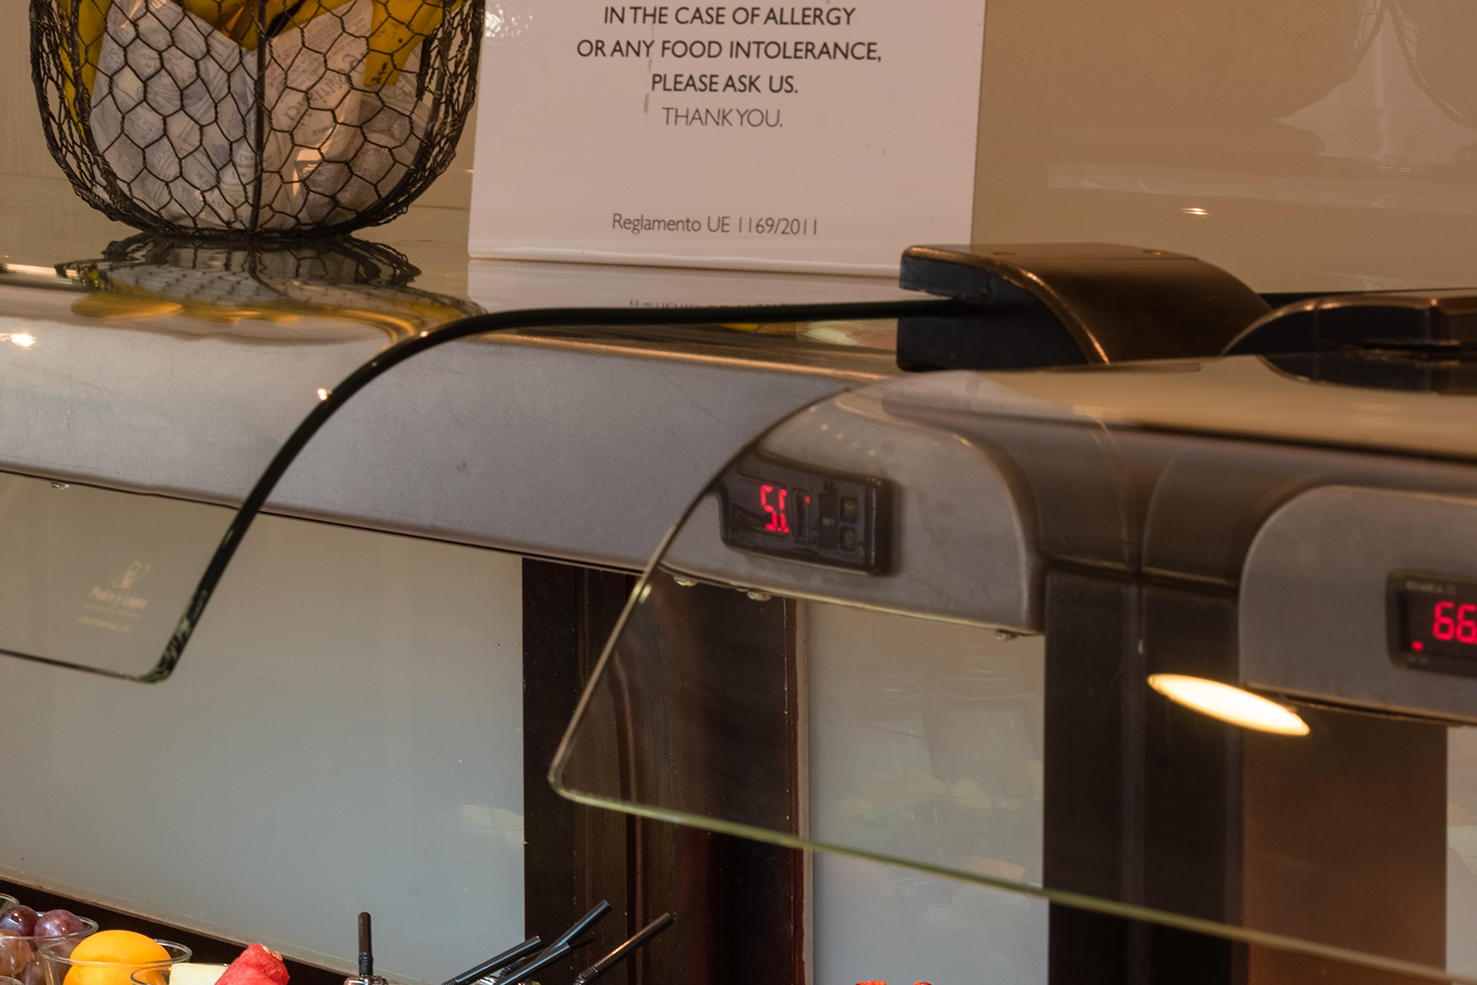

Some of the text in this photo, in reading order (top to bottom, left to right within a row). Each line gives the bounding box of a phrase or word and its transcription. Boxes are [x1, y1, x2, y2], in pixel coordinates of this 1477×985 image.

[604, 6, 857, 26] IN THE CASE OF ALLERGY
[577, 40, 882, 63] OR ANY FOOD INTOLERANCE,
[651, 74, 799, 94] PLEASE ASK US.
[662, 107, 784, 127] THANK YOU.
[612, 213, 817, 236] Reglamento UE 1169/2011
